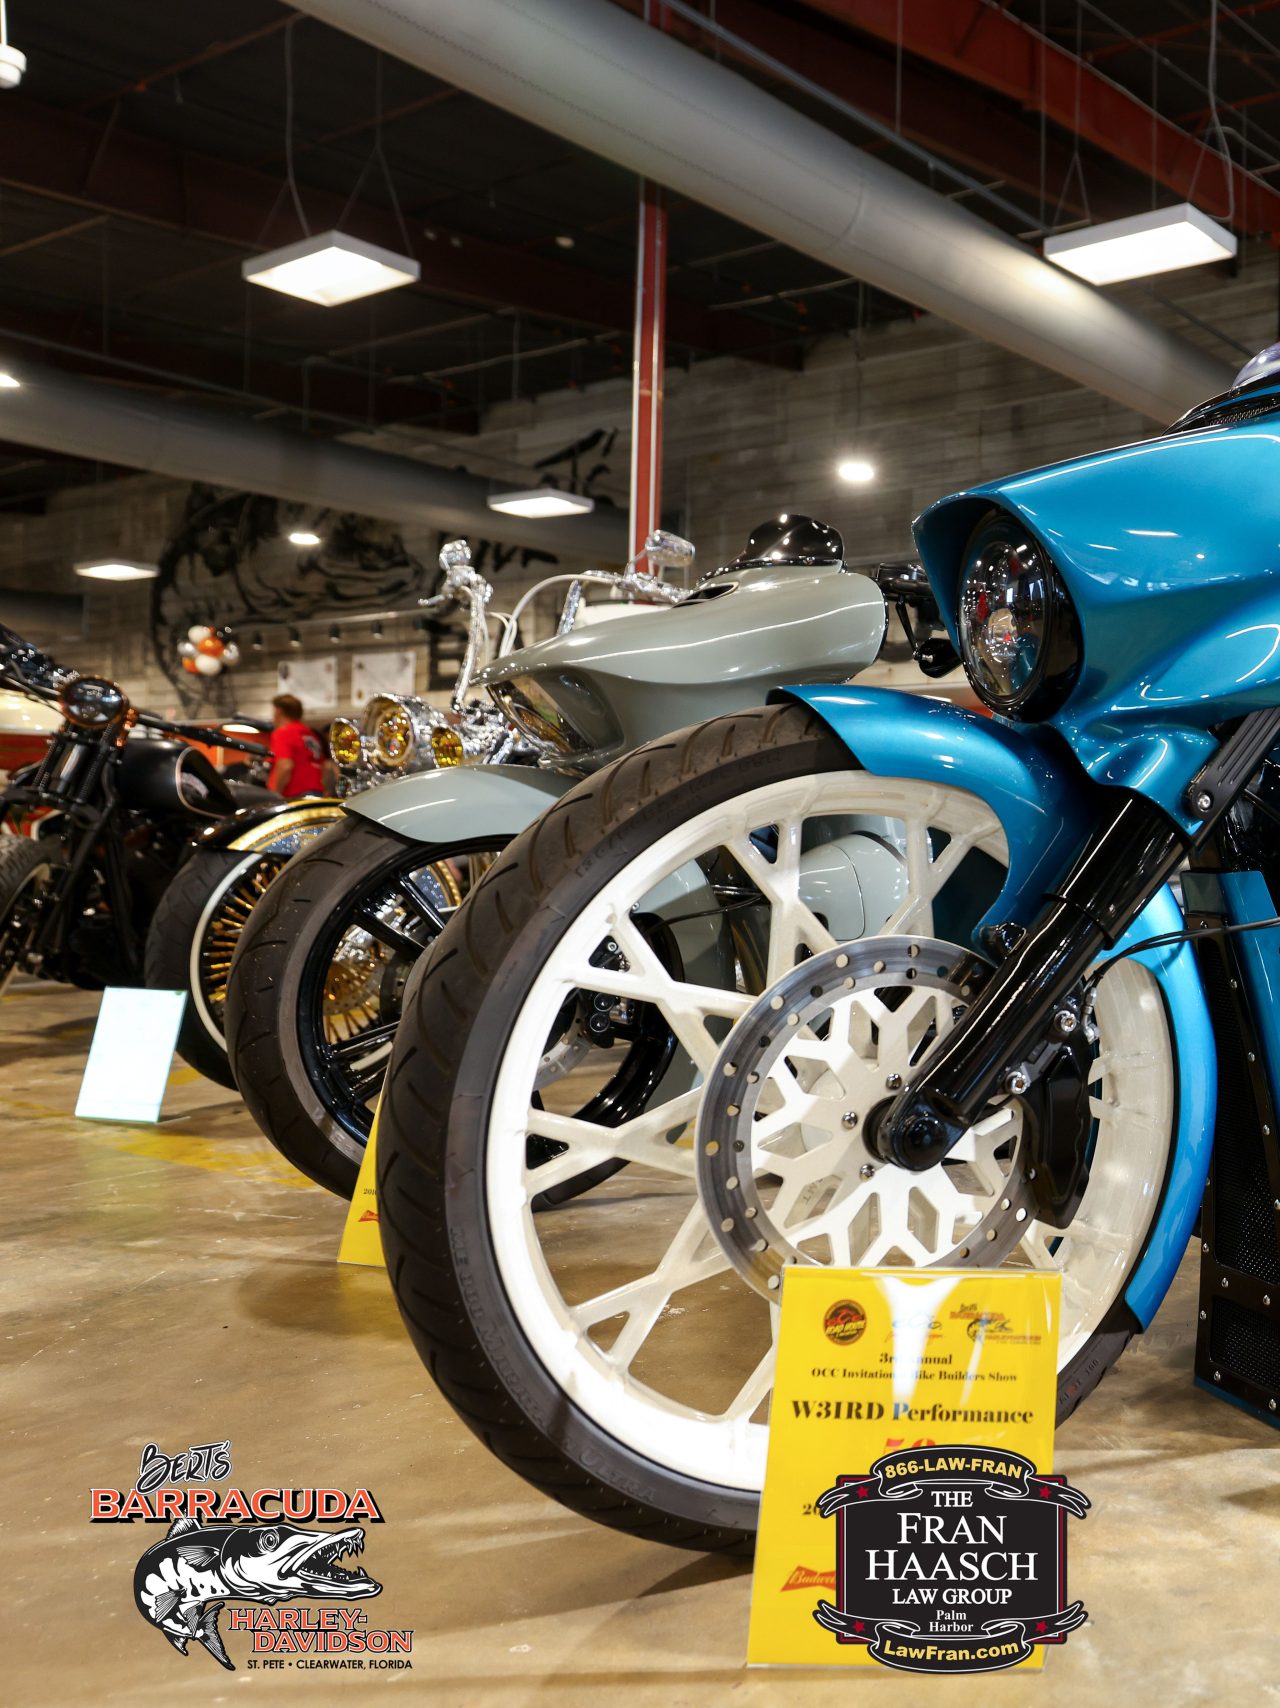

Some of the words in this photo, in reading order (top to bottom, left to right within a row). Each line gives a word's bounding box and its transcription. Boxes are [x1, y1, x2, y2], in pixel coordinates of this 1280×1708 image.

[811, 1367, 840, 1379] OCC
[842, 1368, 900, 1380] Invitation
[913, 1370, 935, 1380] ike
[939, 1370, 986, 1381] Builders
[988, 1371, 1017, 1382] Show
[790, 1400, 885, 1421] W3IRD
[893, 1402, 1034, 1424] Performance
